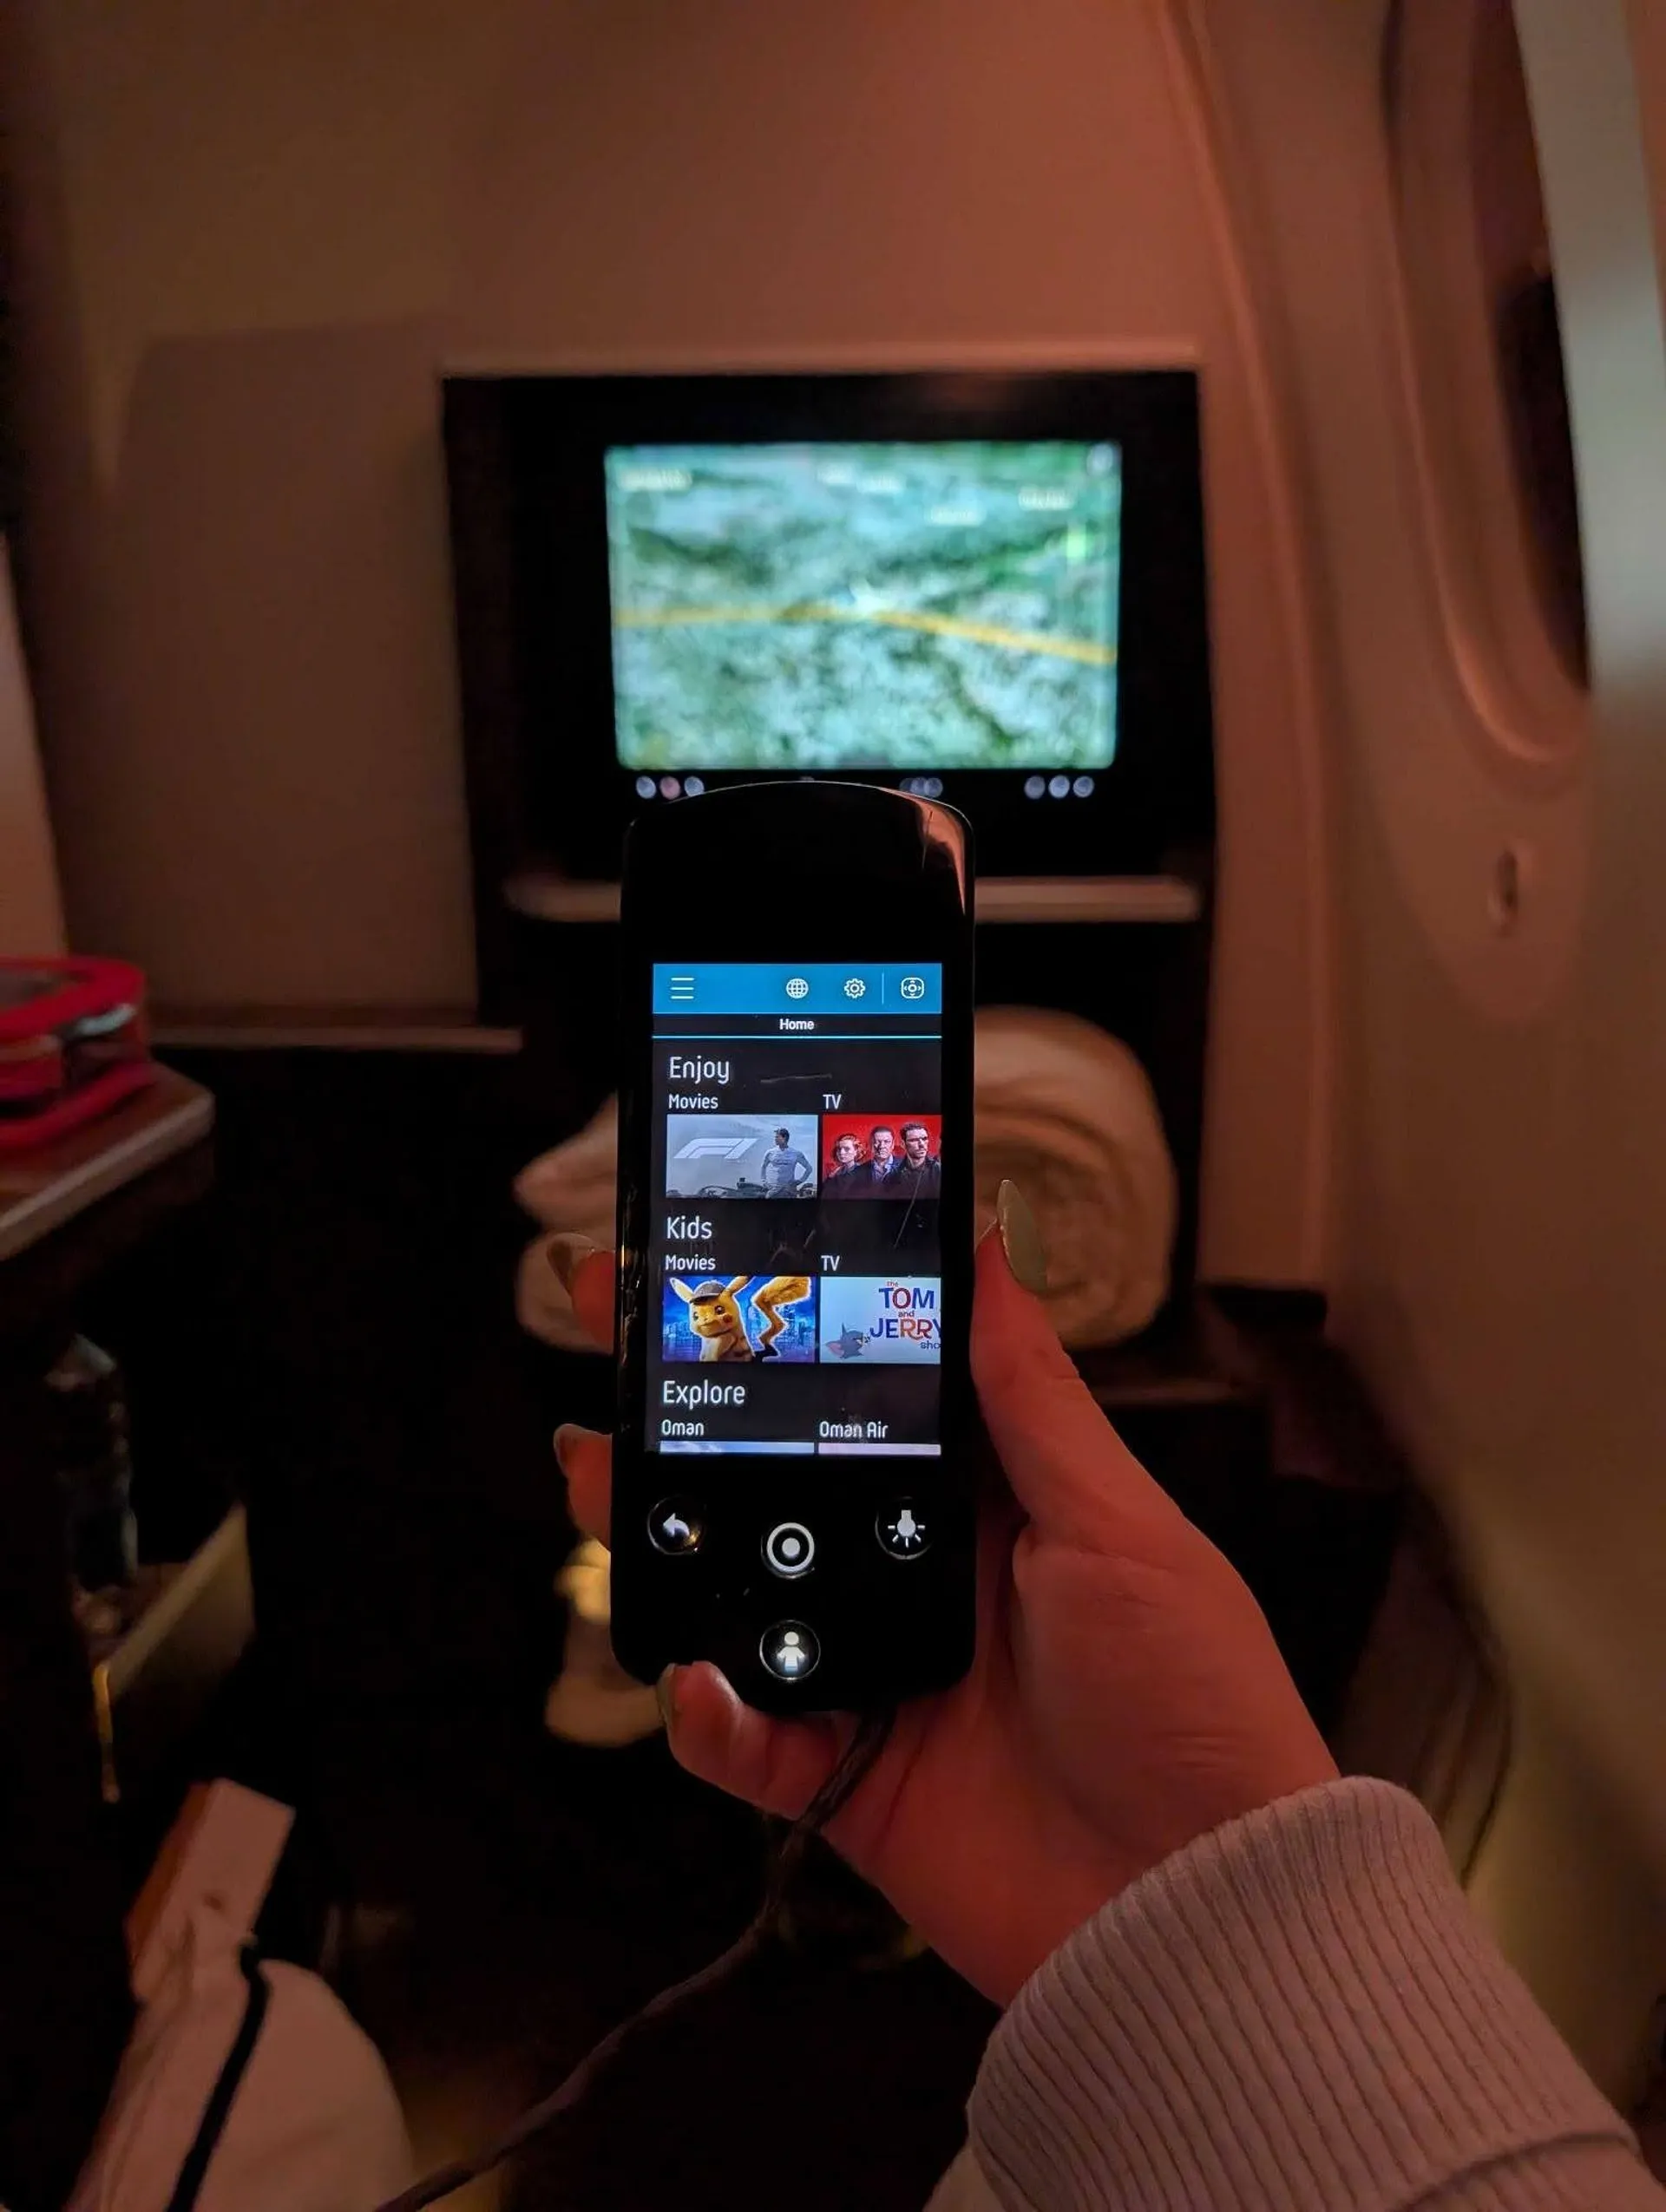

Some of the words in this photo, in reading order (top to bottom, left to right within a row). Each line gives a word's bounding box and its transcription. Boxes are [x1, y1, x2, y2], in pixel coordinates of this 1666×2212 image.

[779, 1018, 815, 1031] Home
[669, 1056, 731, 1084] Enjoy
[668, 1093, 718, 1109] Movies
[823, 1094, 842, 1109] TV
[666, 1216, 712, 1240] Kids
[665, 1254, 717, 1271] Movies
[821, 1255, 840, 1271] TV
[878, 1287, 935, 1310] TOM
[663, 1380, 746, 1410] Explore
[661, 1420, 705, 1436] Oman
[819, 1422, 863, 1438] Oman
[866, 1422, 889, 1438] Air
